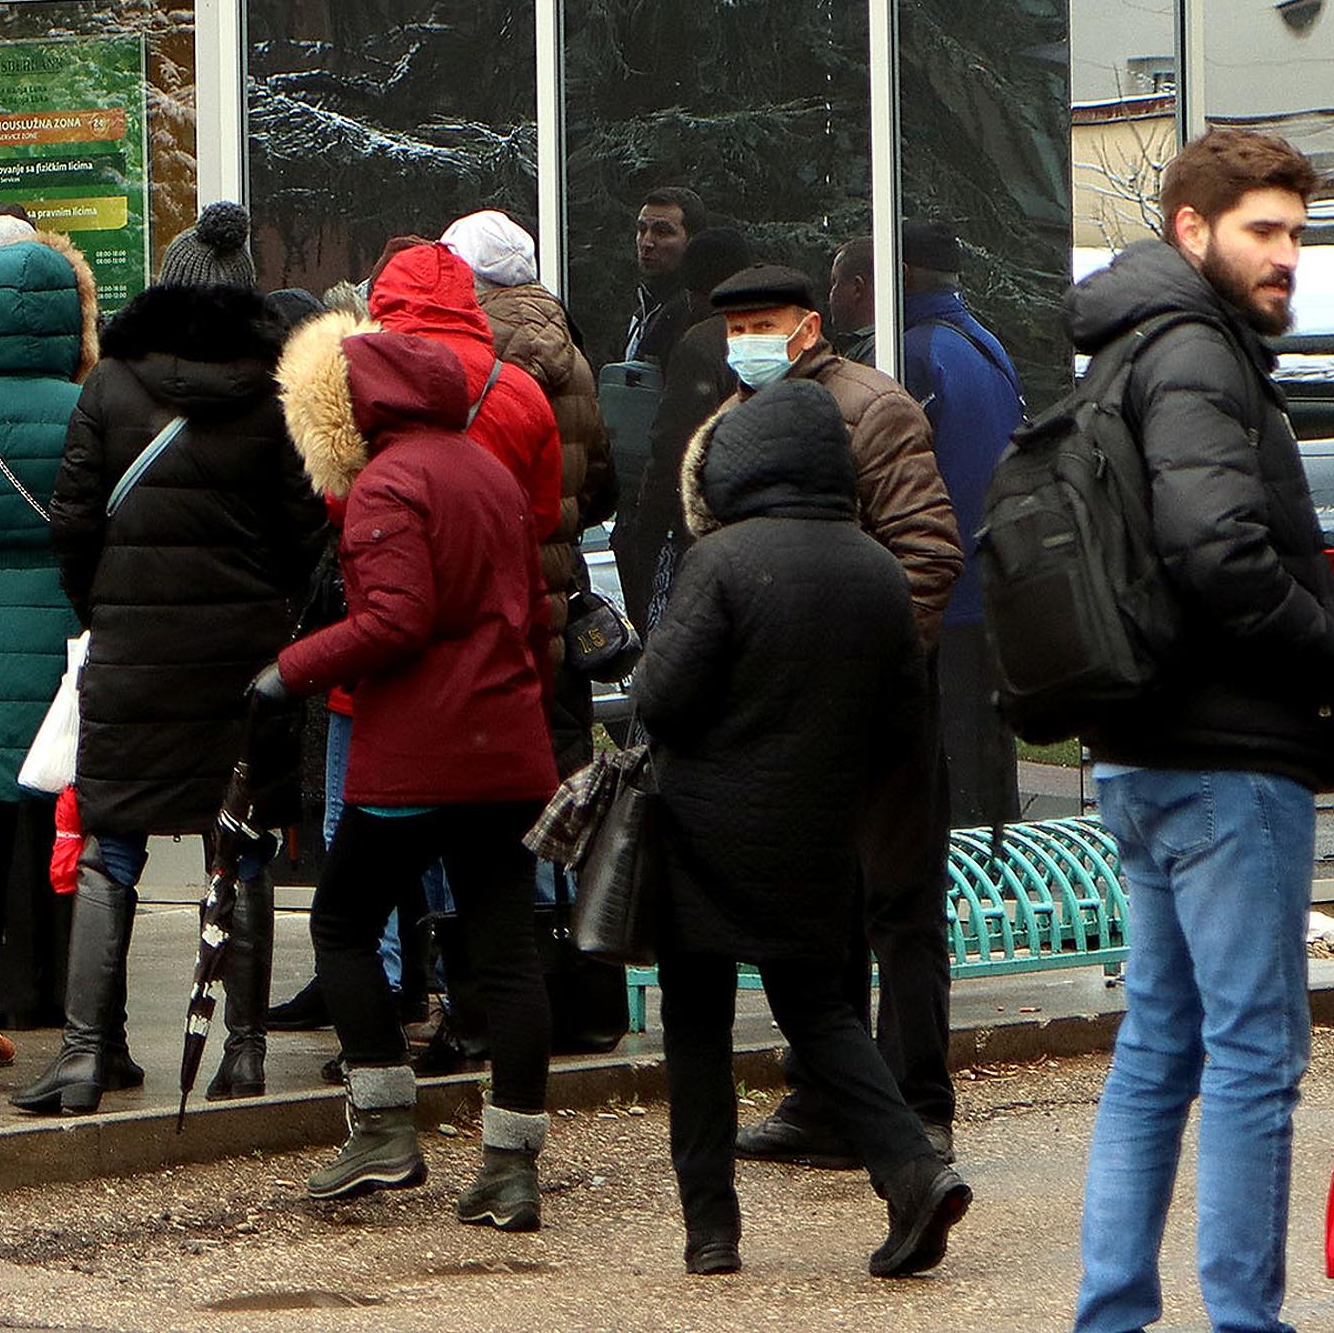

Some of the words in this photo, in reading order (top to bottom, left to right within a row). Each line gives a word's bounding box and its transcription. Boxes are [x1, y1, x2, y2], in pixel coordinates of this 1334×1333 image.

[54, 118, 82, 129] ZONA
[36, 162, 67, 174] fizičkim
[68, 161, 93, 171] licima
[37, 208, 72, 219] pravnim
[73, 206, 97, 217] licima
